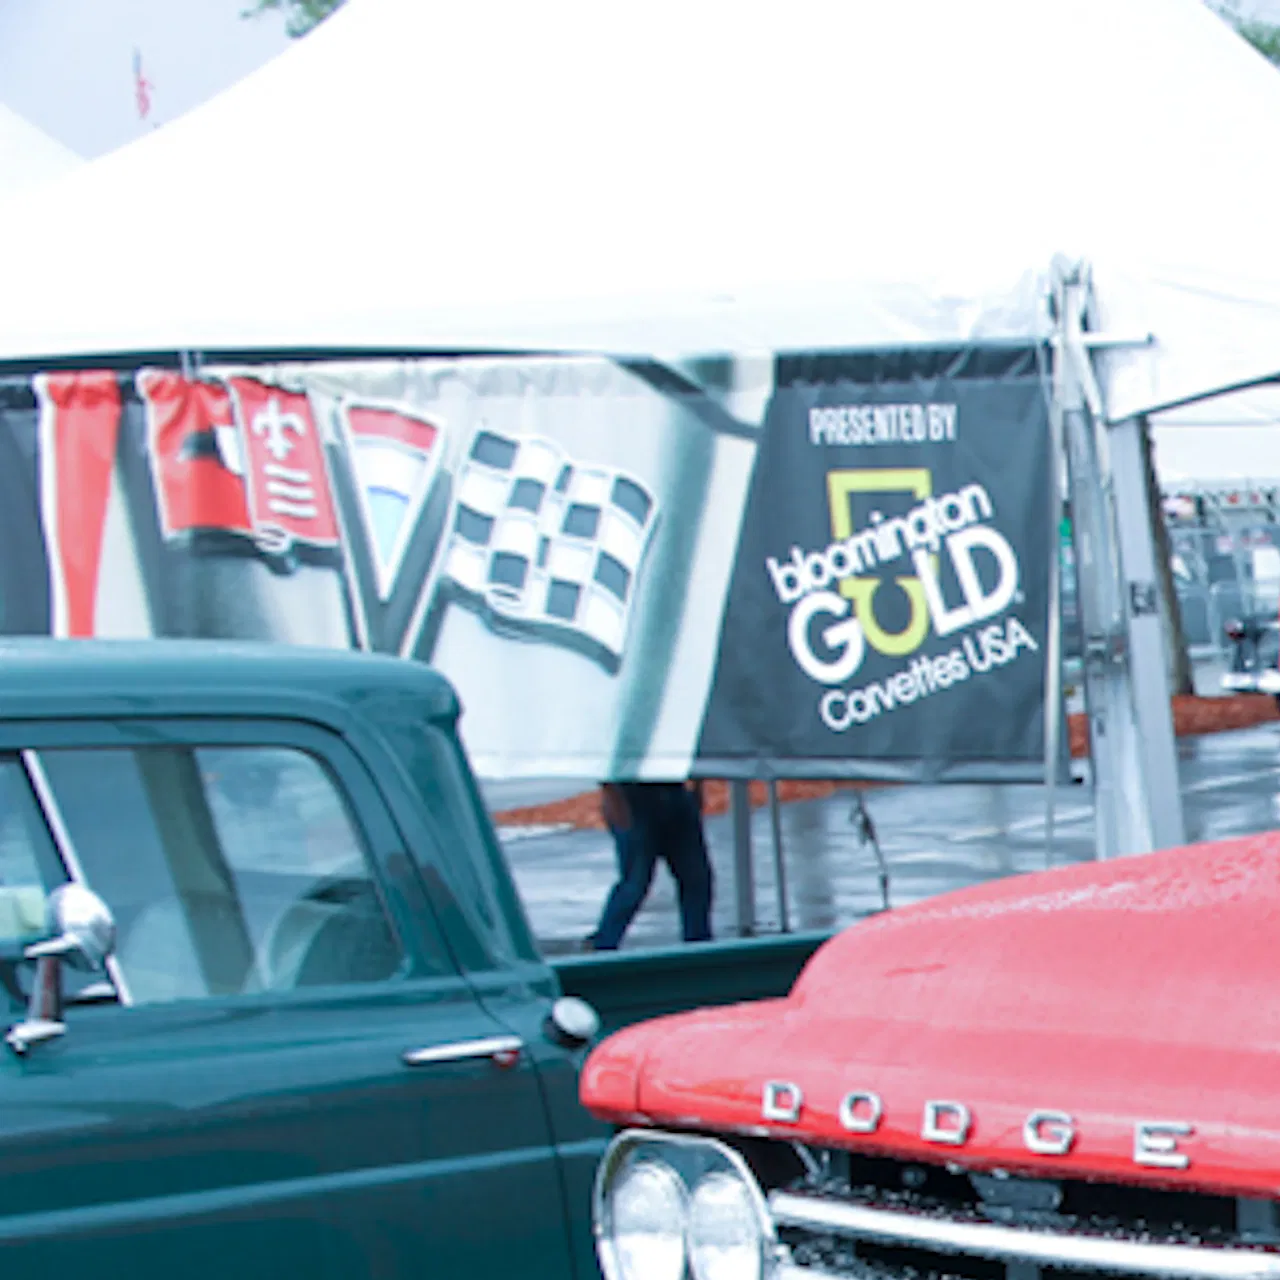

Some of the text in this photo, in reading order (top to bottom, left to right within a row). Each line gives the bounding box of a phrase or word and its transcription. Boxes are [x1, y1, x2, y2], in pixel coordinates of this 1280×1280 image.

[809, 404, 958, 444] PRESENTED BY
[766, 482, 994, 604] bloomington
[787, 525, 1018, 686] GOLD
[818, 617, 1039, 732] Corvettes USA
[761, 1078, 1196, 1171] DODGE
